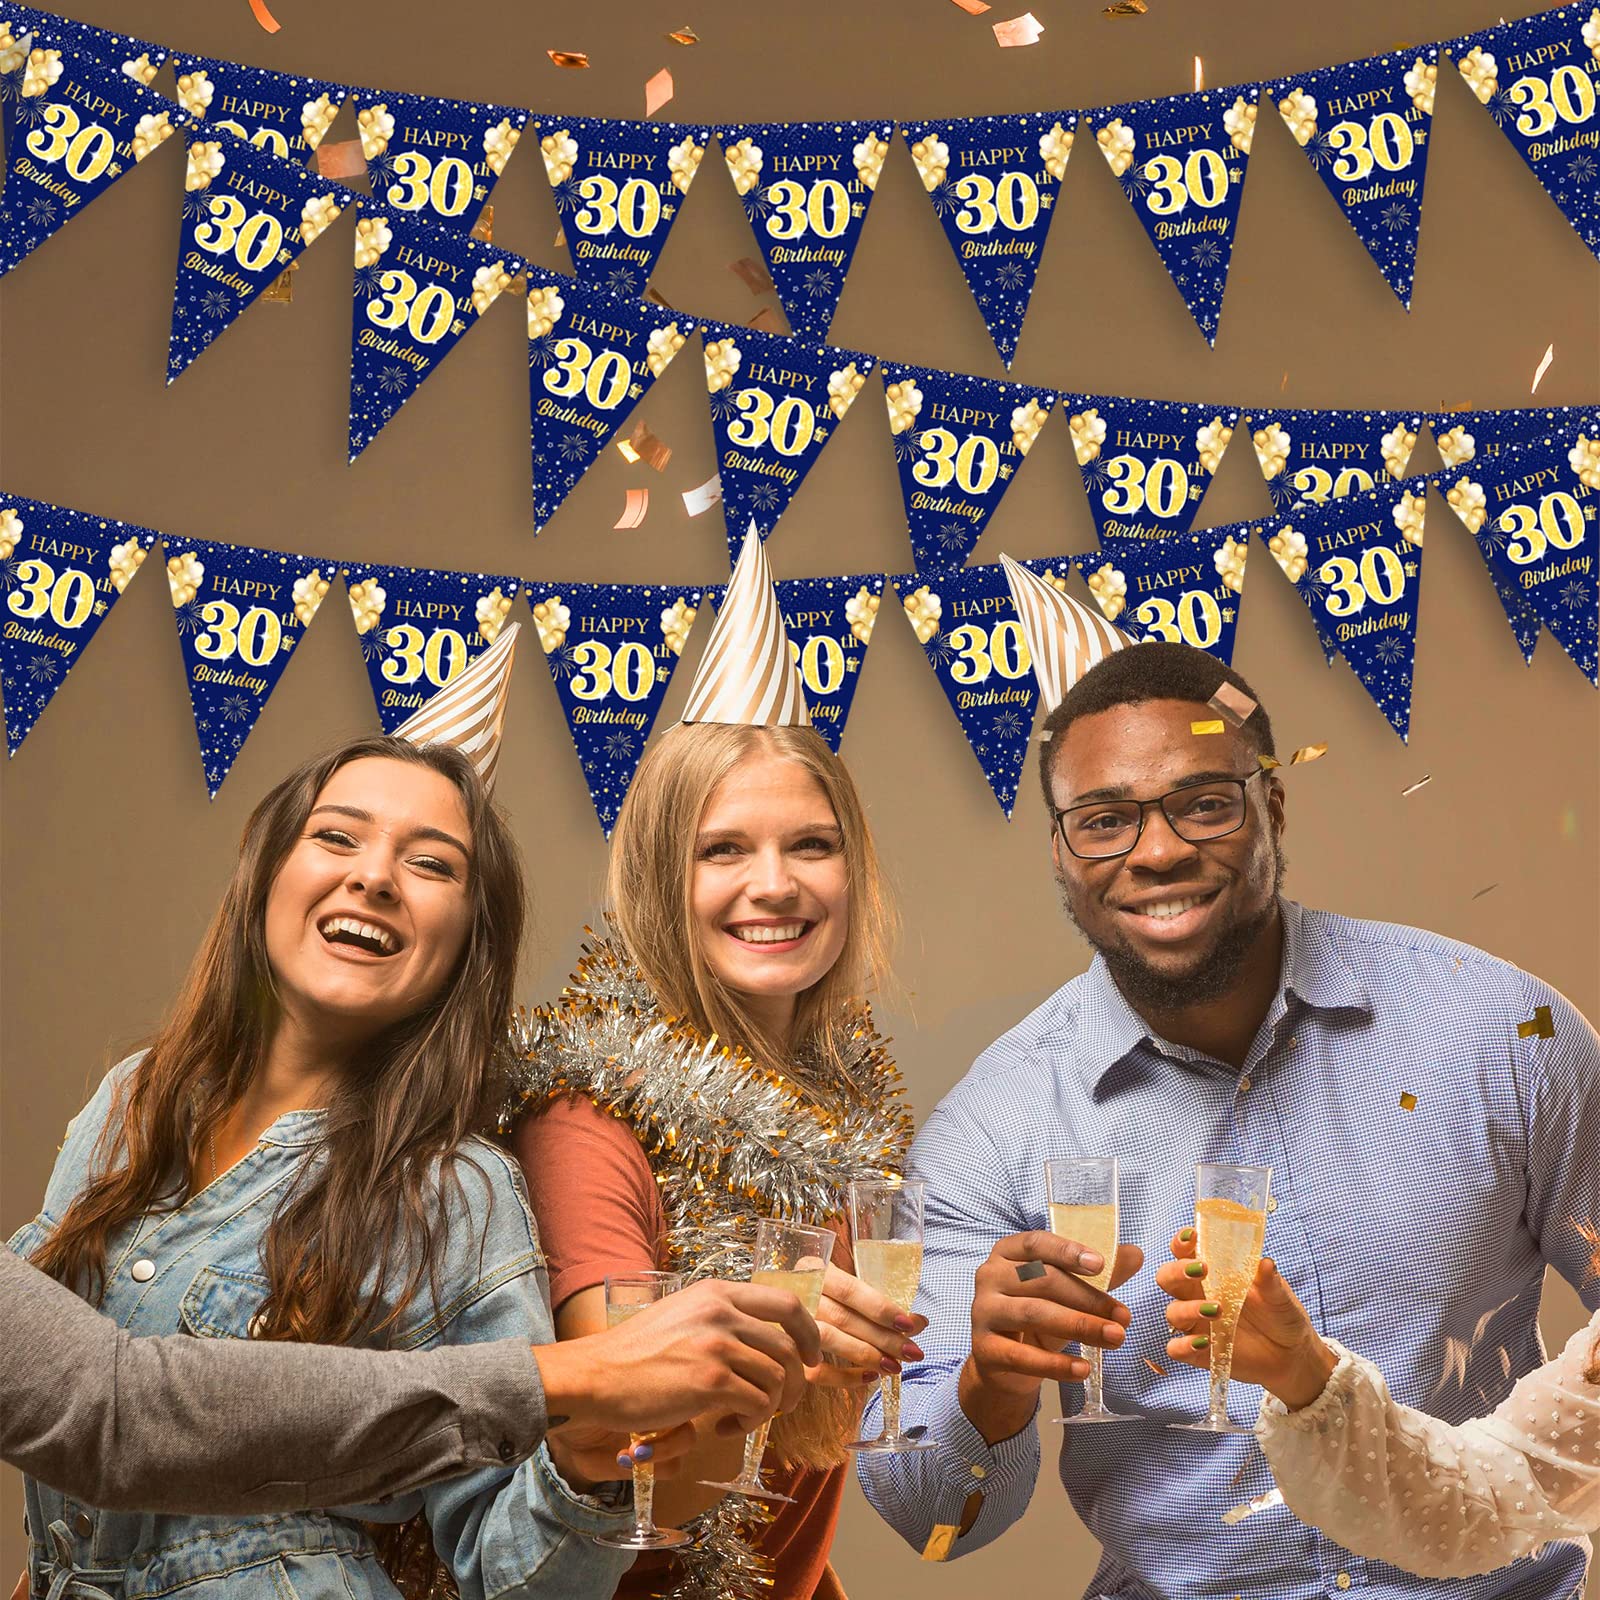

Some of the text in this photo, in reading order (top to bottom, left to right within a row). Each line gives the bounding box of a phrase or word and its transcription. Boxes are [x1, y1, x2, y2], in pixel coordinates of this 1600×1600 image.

[1507, 39, 1571, 72] HAPPY
[63, 81, 129, 125] HAPPY
[221, 95, 290, 122] HAPPY
[1327, 86, 1393, 116] HAPPY
[403, 127, 472, 150] HAPPY
[1146, 123, 1212, 148] HAPPY
[1527, 130, 1600, 161] Birthday
[588, 151, 656, 170] HAPPY
[774, 154, 841, 172] HAPPY
[960, 147, 1027, 166] HAPPY
[13, 157, 81, 207] Birthday
[227, 171, 294, 211] HAPPY
[1342, 178, 1417, 206] Birthday
[1154, 215, 1230, 240] Birthday
[576, 241, 652, 267] Birthday
[770, 245, 846, 267] Birthday
[961, 238, 1037, 259] Birthday
[184, 251, 254, 297] Birthday
[396, 245, 464, 282] HAPPY
[569, 313, 637, 346] HAPPY
[358, 328, 430, 371] Birthday
[748, 363, 817, 391] HAPPY
[537, 398, 610, 438] Birthday
[931, 403, 1000, 428] HAPPY
[1116, 430, 1184, 450] HAPPY
[1301, 443, 1369, 459] HAPPY
[724, 450, 798, 485] Birthday
[1495, 465, 1558, 501] HAPPY
[911, 491, 985, 523] Birthday
[30, 534, 99, 564] HAPPY
[1317, 520, 1382, 552] HAPPY
[1137, 564, 1202, 591] HAPPY
[1519, 555, 1593, 589] Birthday
[212, 575, 281, 600] HAPPY
[395, 600, 464, 620] HAPPY
[782, 610, 834, 629] APPY
[580, 616, 648, 633] HAPPY
[1335, 612, 1410, 641] Birthday
[3, 621, 77, 657] Birthday
[193, 664, 268, 695] Birthday
[956, 686, 1033, 709] Birthday
[572, 706, 648, 730] Birthday
